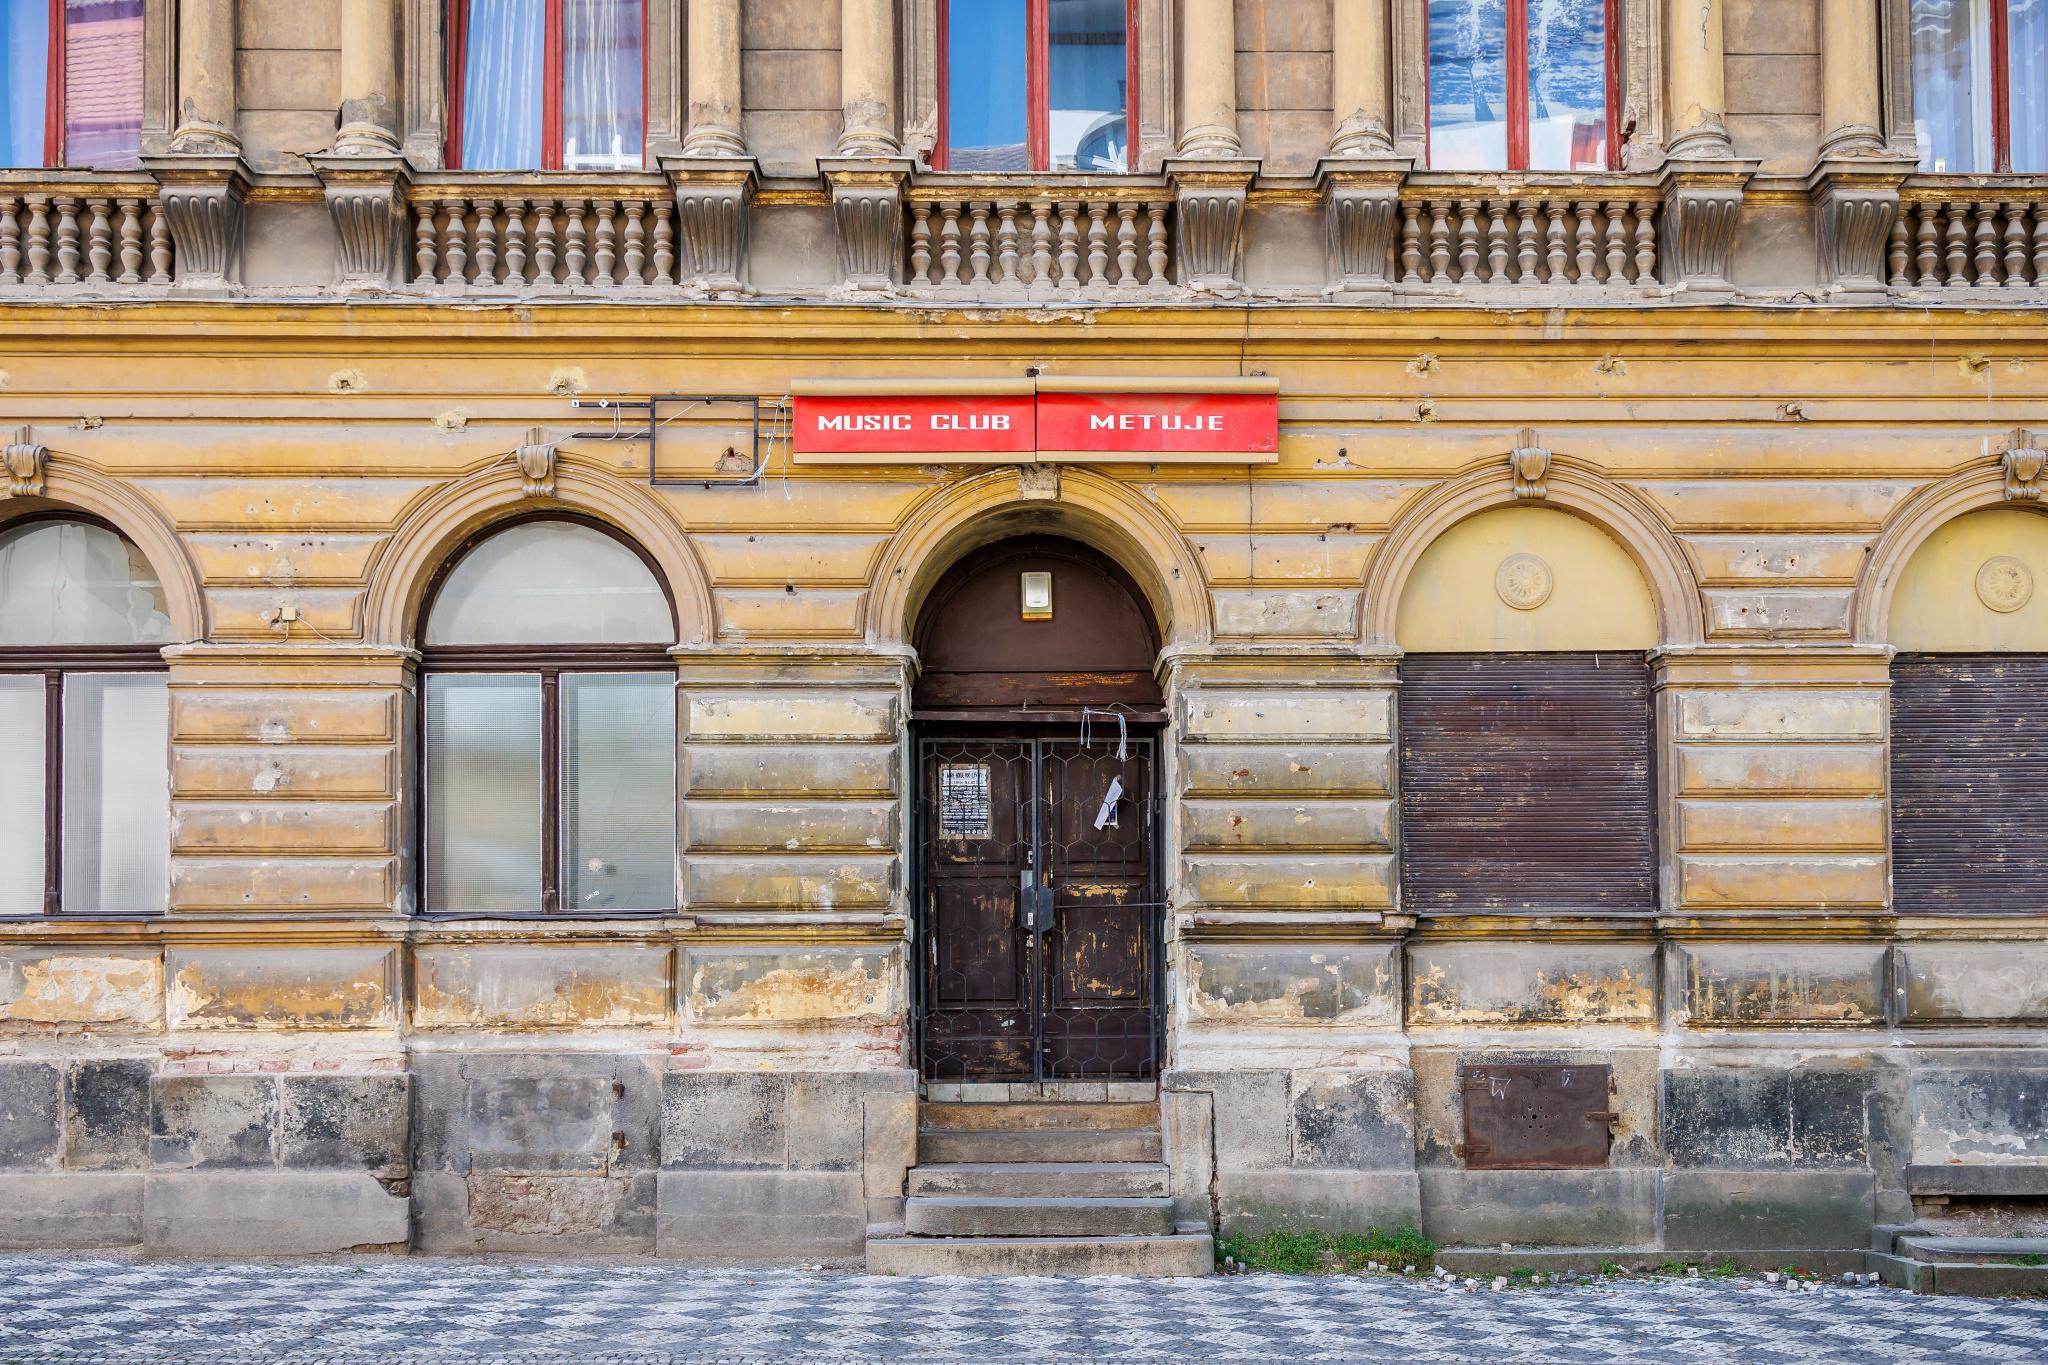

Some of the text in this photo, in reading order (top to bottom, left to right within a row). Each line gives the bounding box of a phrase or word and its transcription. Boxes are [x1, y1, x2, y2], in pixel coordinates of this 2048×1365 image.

[818, 414, 1224, 431] MUSIC CLUB METUJE
